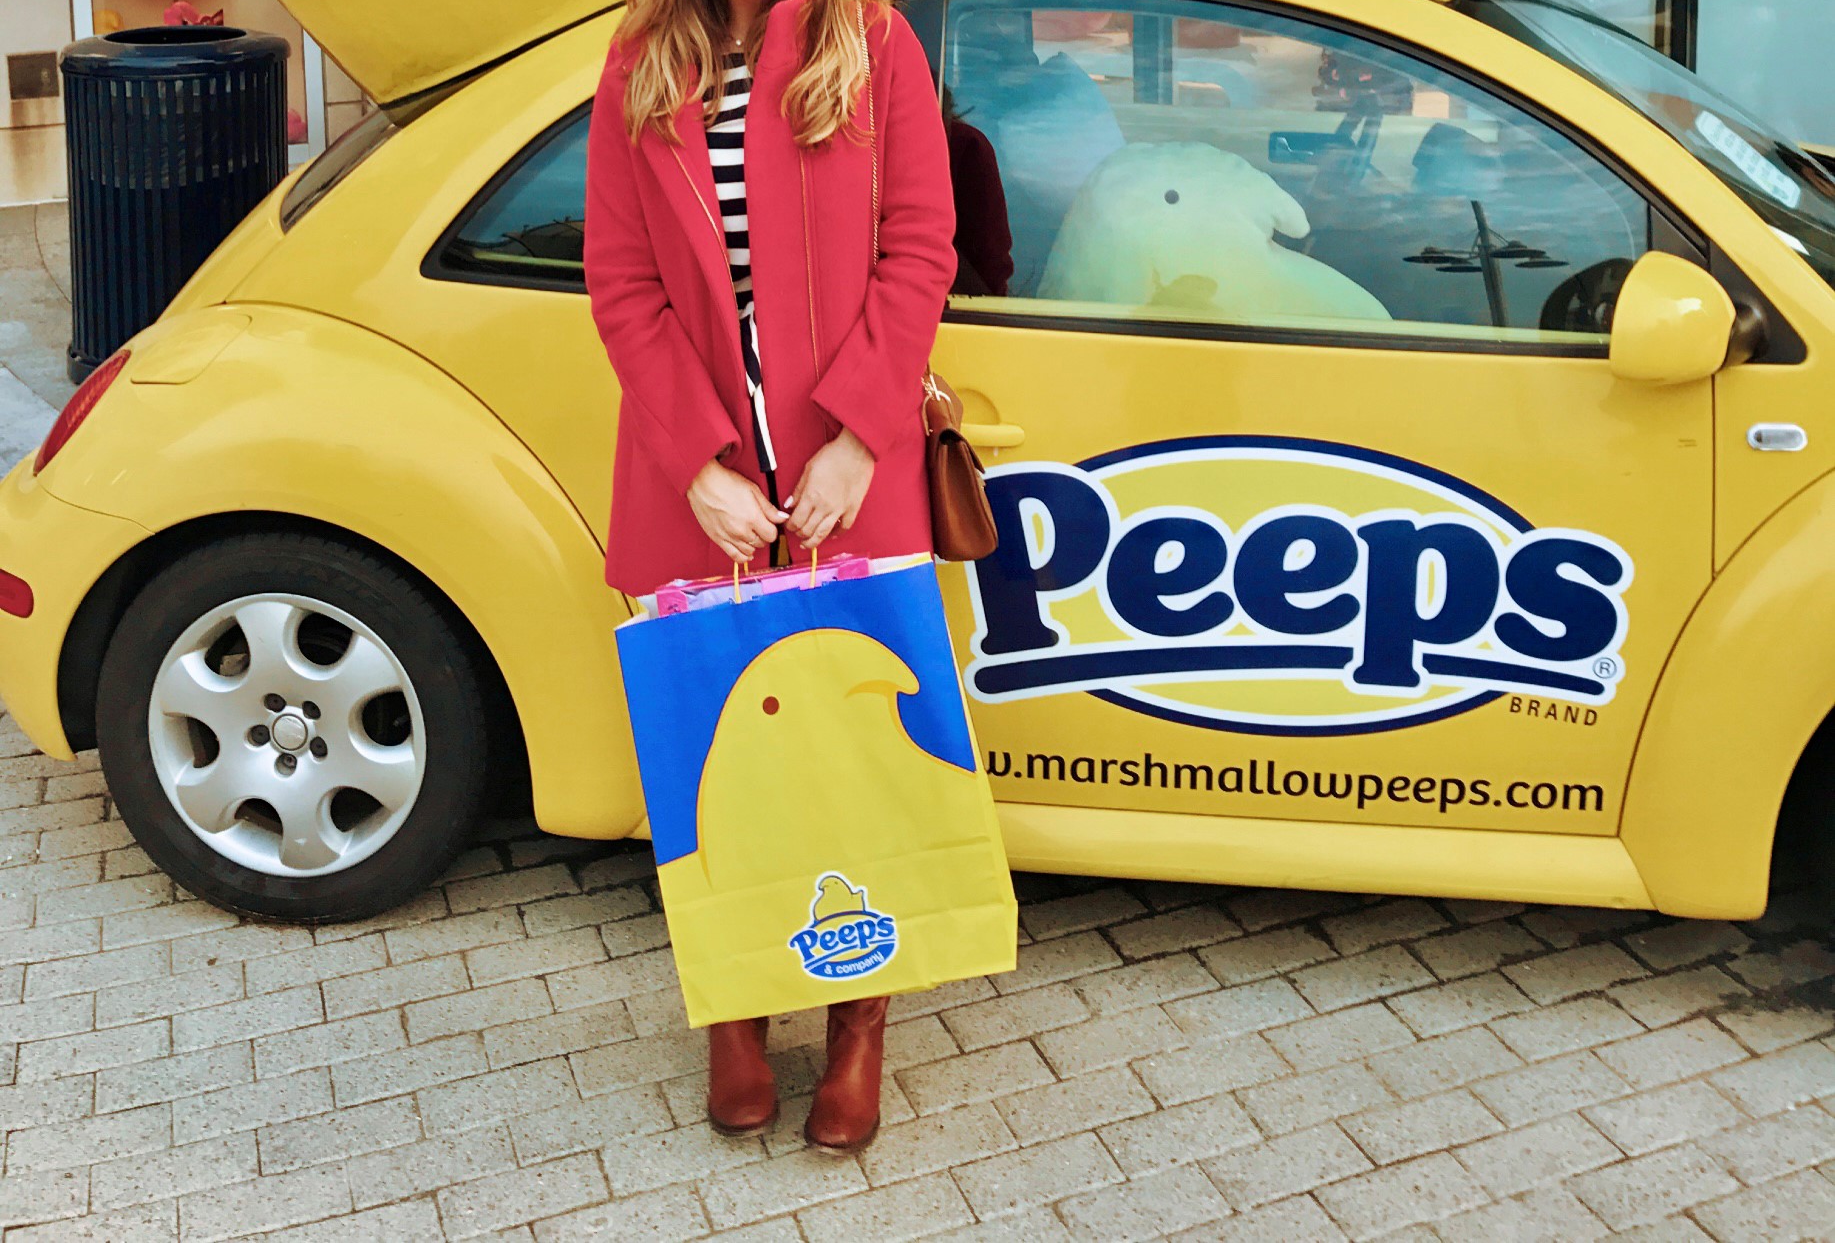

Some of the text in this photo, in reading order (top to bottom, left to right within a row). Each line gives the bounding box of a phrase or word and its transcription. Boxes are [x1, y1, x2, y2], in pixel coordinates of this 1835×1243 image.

[979, 470, 1624, 688] Peeps
[1509, 696, 1599, 727] BRAND
[789, 916, 895, 963] Peeps
[823, 950, 885, 976] & company
